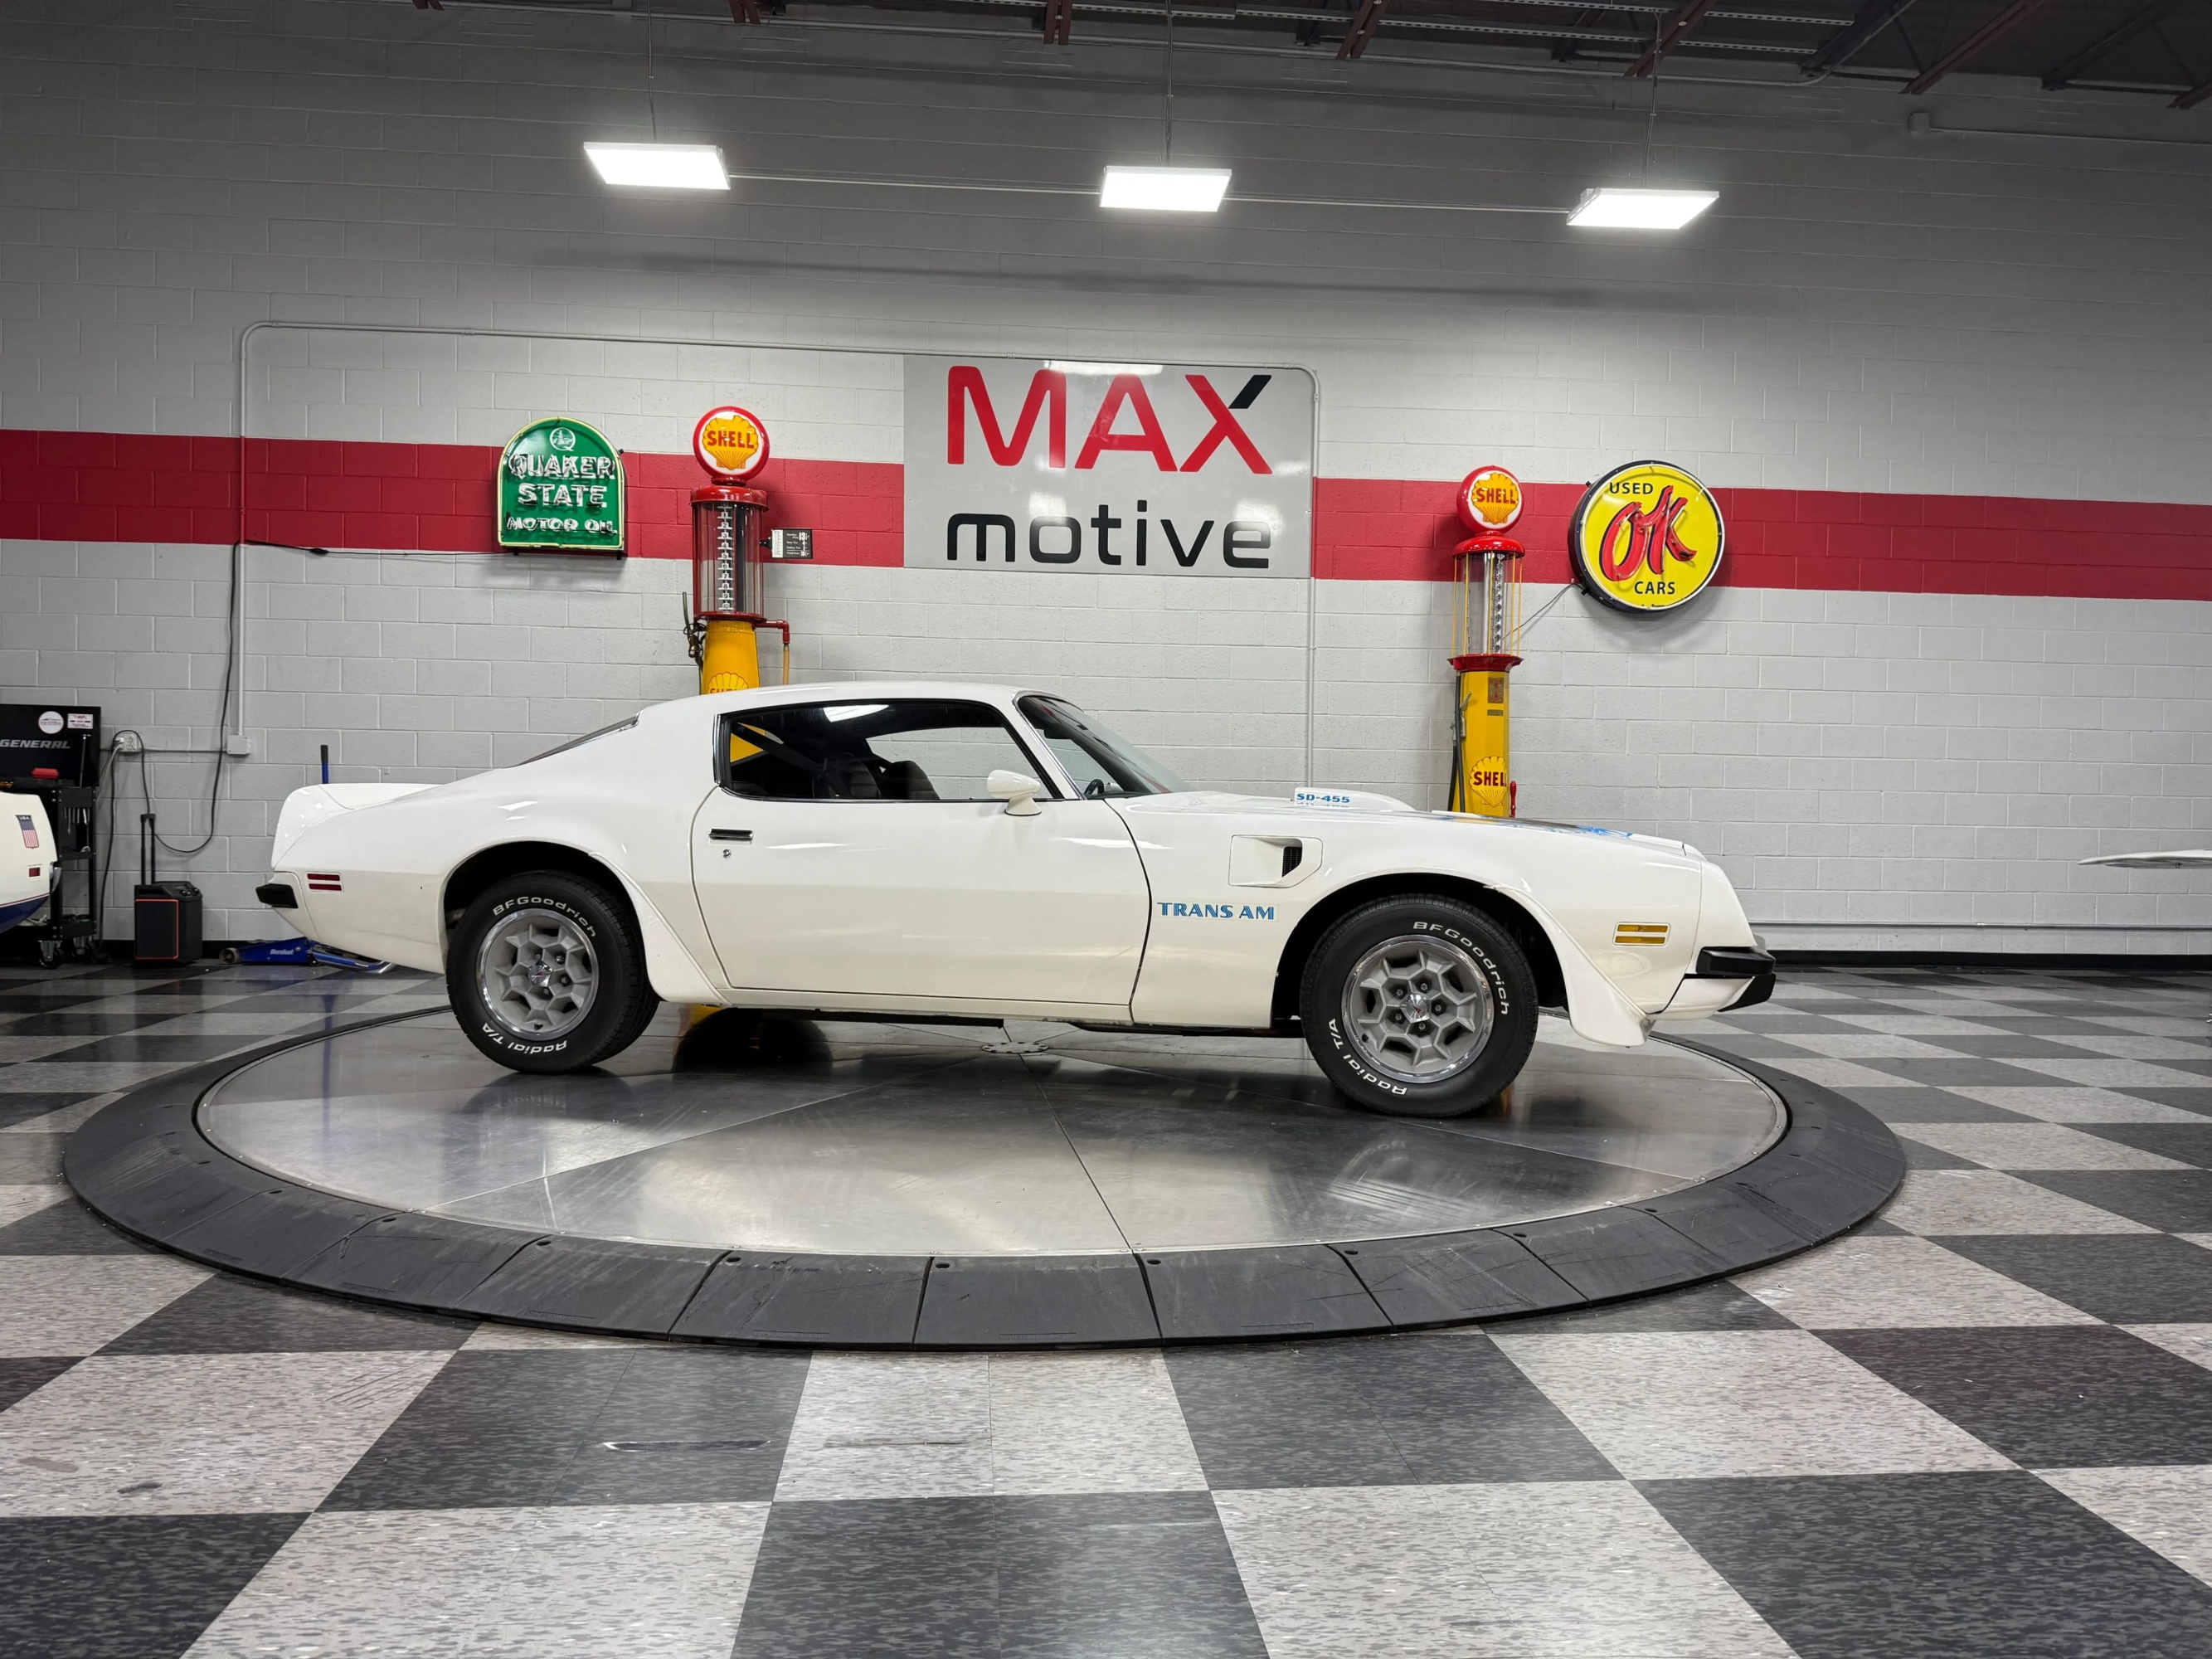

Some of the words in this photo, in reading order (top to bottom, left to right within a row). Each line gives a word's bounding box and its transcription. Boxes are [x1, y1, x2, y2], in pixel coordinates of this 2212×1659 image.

[947, 365, 1272, 474] MAX
[707, 430, 755, 450] SHELL
[508, 454, 615, 479] QUAKER
[518, 483, 607, 508] STATE
[1475, 487, 1516, 505] SHELL
[1609, 482, 1654, 495] USED
[506, 517, 578, 532] MOTOR
[584, 518, 618, 534] OIL
[946, 499, 1271, 569] motive
[1599, 485, 1698, 582] OK
[1634, 581, 1675, 595] CARS
[0, 739, 70, 749] GENERAL
[1296, 793, 1350, 803] SD-455
[493, 896, 596, 938] BFGoodrich
[1157, 902, 1233, 918] TRANS
[1239, 905, 1274, 920] AM
[1412, 921, 1510, 1015] BFGoodrich
[482, 1022, 503, 1044] T/A
[1328, 1018, 1344, 1049] T/A
[508, 1039, 567, 1054] Radial
[1343, 1053, 1407, 1095] Radial
